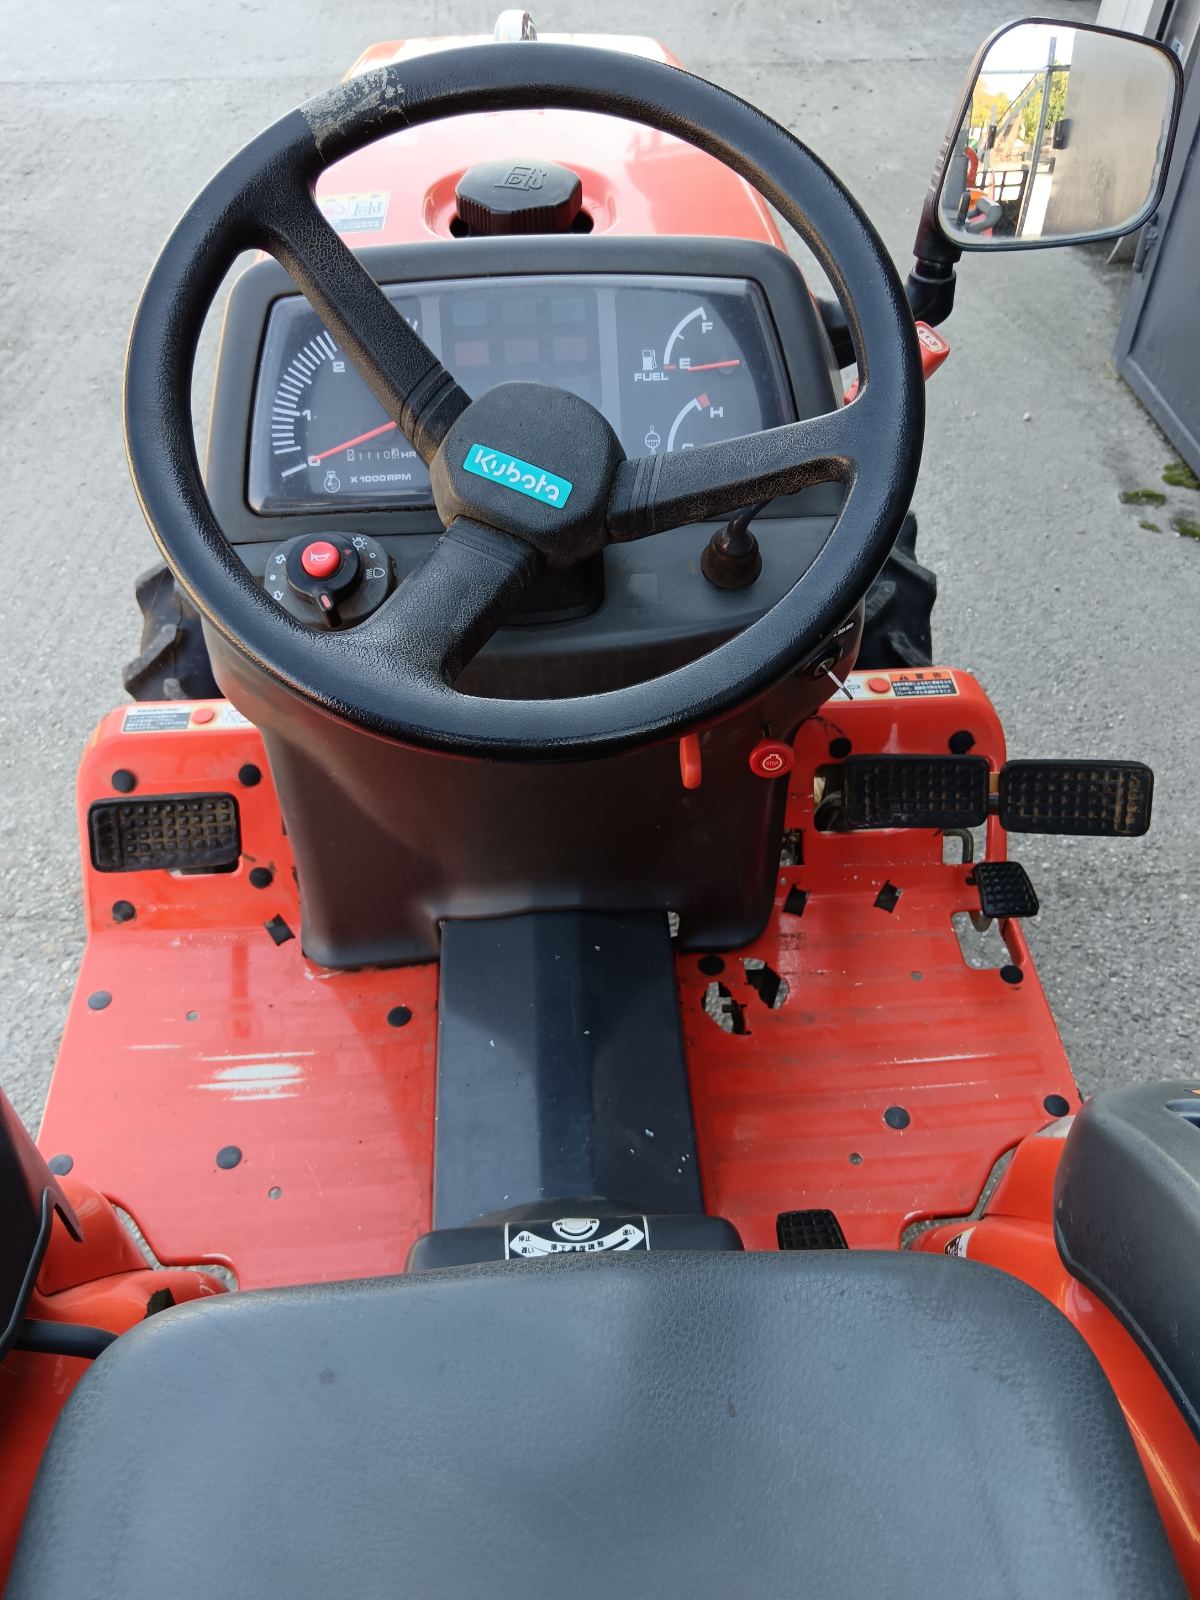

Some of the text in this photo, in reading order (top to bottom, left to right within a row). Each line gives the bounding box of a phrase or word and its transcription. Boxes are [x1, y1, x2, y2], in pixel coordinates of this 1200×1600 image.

[701, 321, 713, 334] F
[332, 361, 346, 373] 2
[679, 357, 691, 370] E
[634, 372, 670, 382] FUEL
[302, 409, 312, 421] 1
[709, 406, 724, 418] H
[401, 451, 417, 459] HR
[308, 456, 321, 467] 0
[474, 449, 560, 502] Kubota
